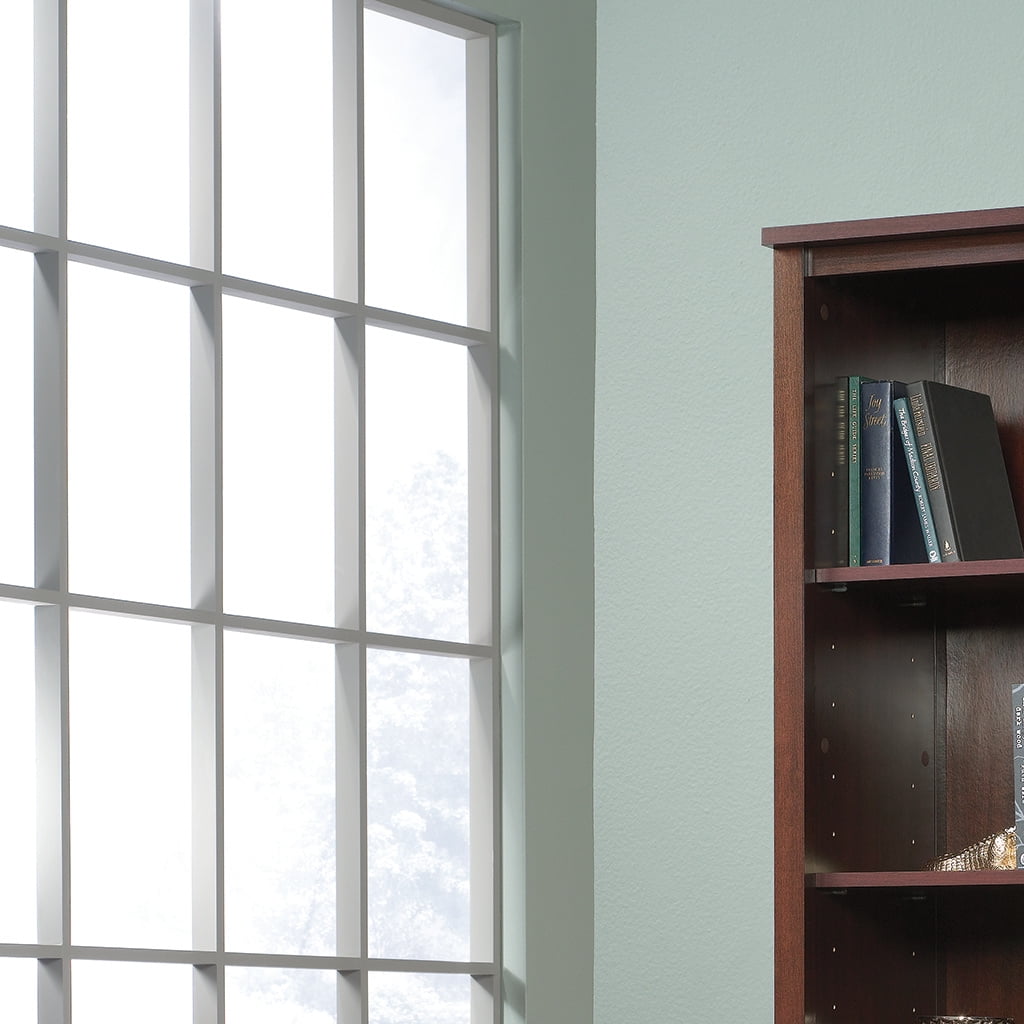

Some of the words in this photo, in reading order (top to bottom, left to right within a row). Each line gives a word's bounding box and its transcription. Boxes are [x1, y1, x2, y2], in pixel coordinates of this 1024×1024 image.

[868, 394, 884, 411] Joy
[864, 412, 887, 432] Street
[901, 420, 910, 440] Bridges
[908, 447, 917, 471] Madison
[913, 471, 922, 492] County
